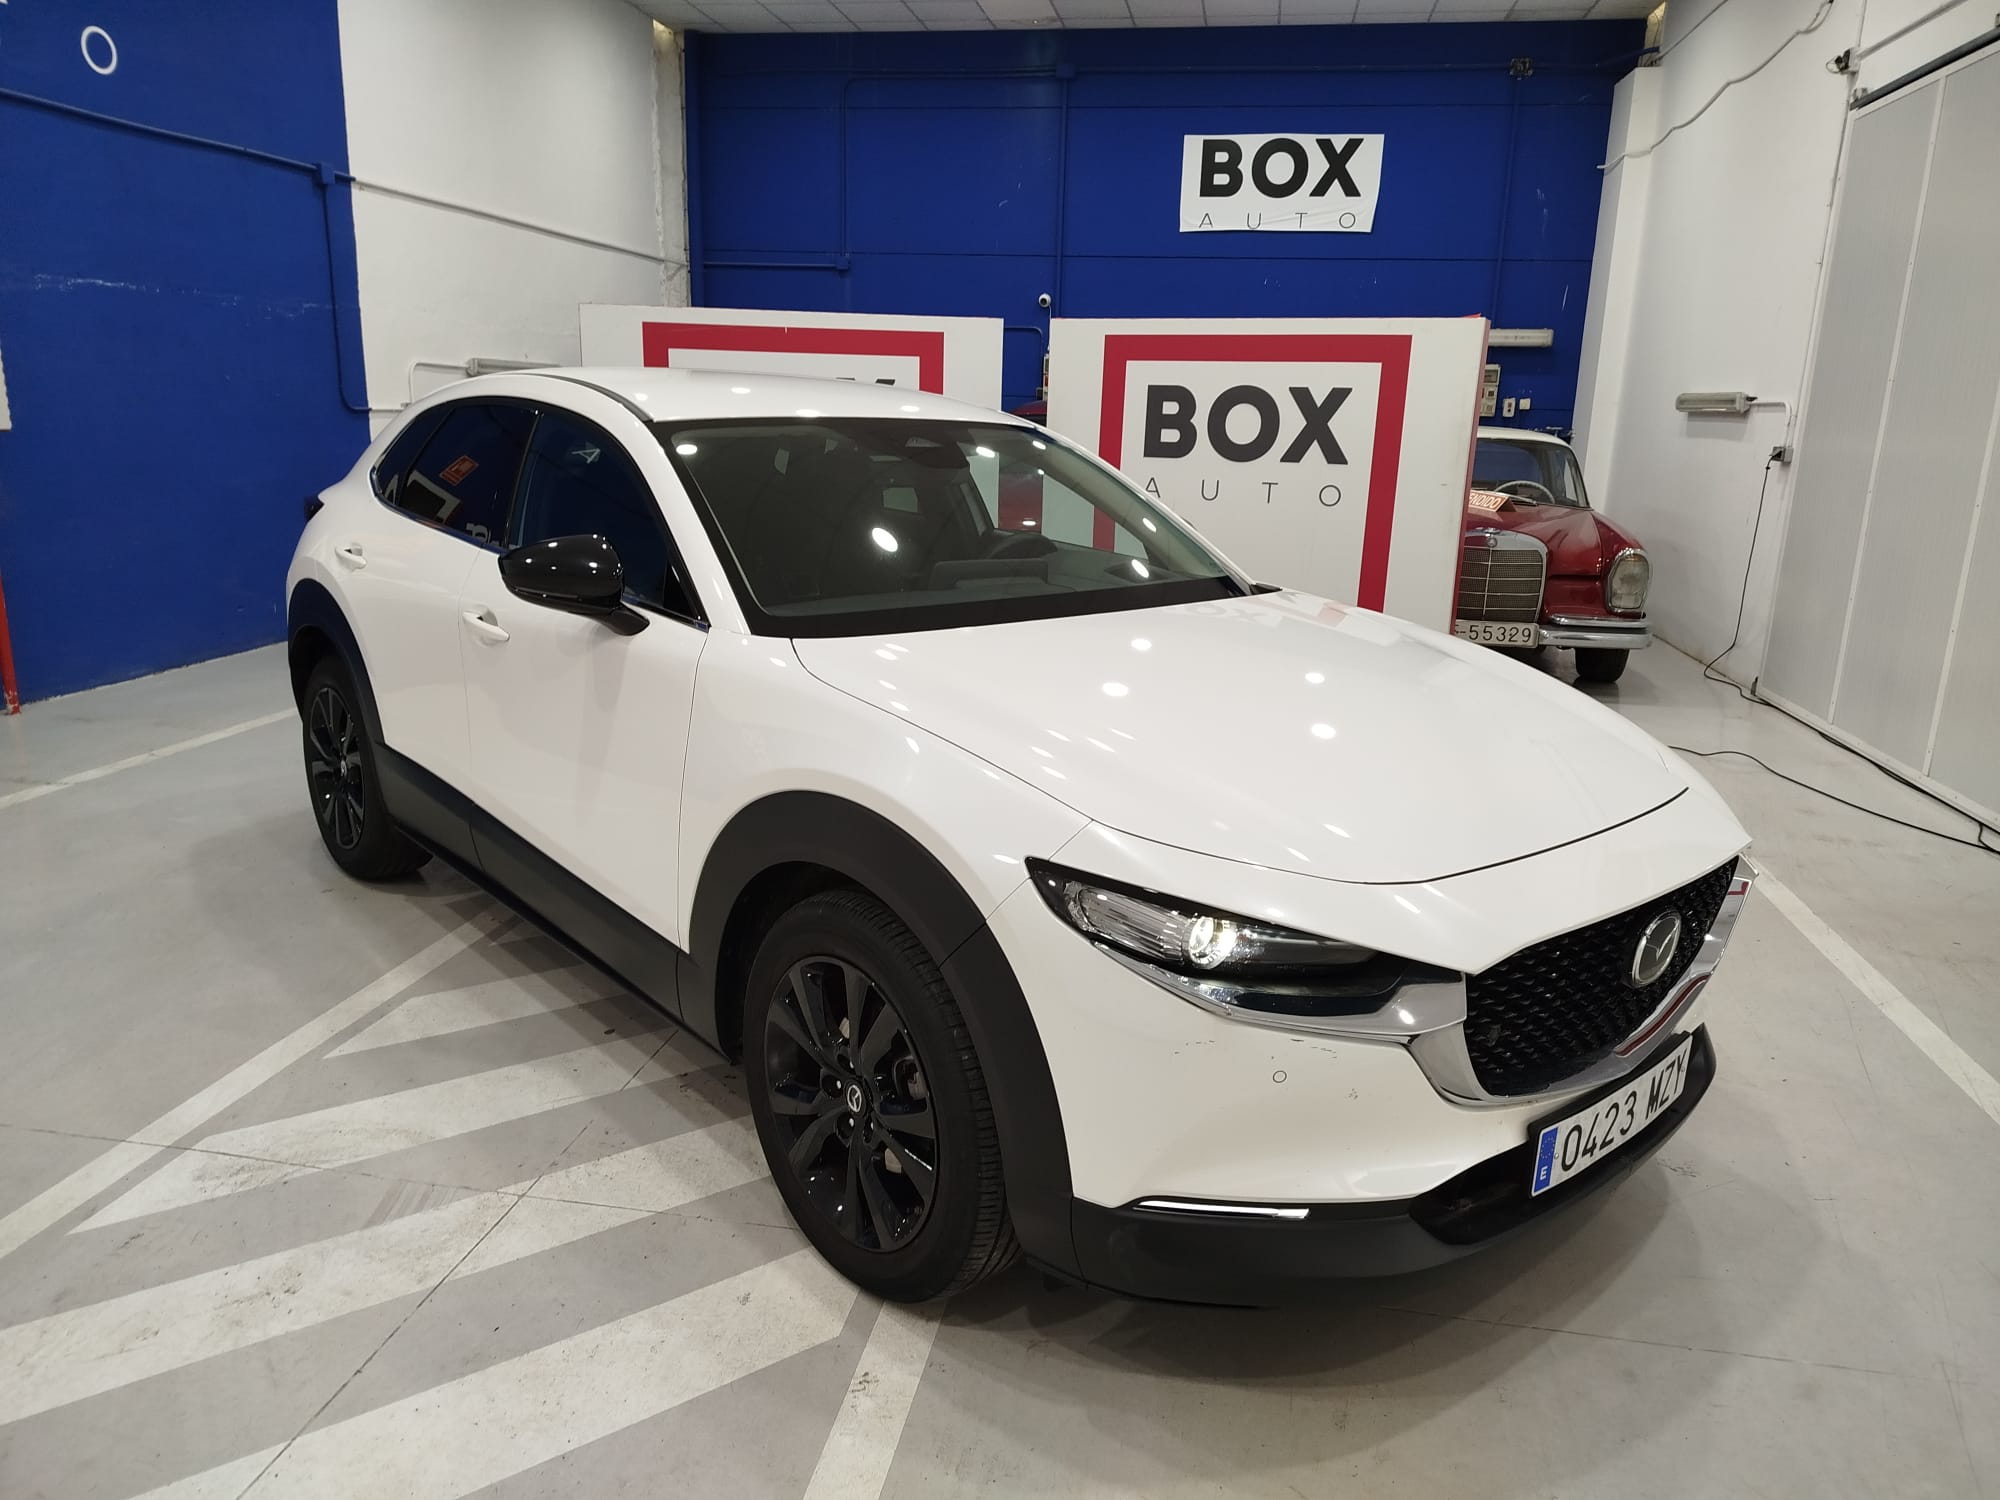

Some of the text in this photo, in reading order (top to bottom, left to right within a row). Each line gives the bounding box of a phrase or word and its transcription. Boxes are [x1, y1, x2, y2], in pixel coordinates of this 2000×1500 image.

[1199, 137, 1365, 199] BOX
[1199, 212, 1356, 230] AUTO
[1143, 384, 1353, 465] BOX
[1145, 477, 1342, 507] AUTO
[1539, 1047, 1688, 1180] E 0423 MZY
